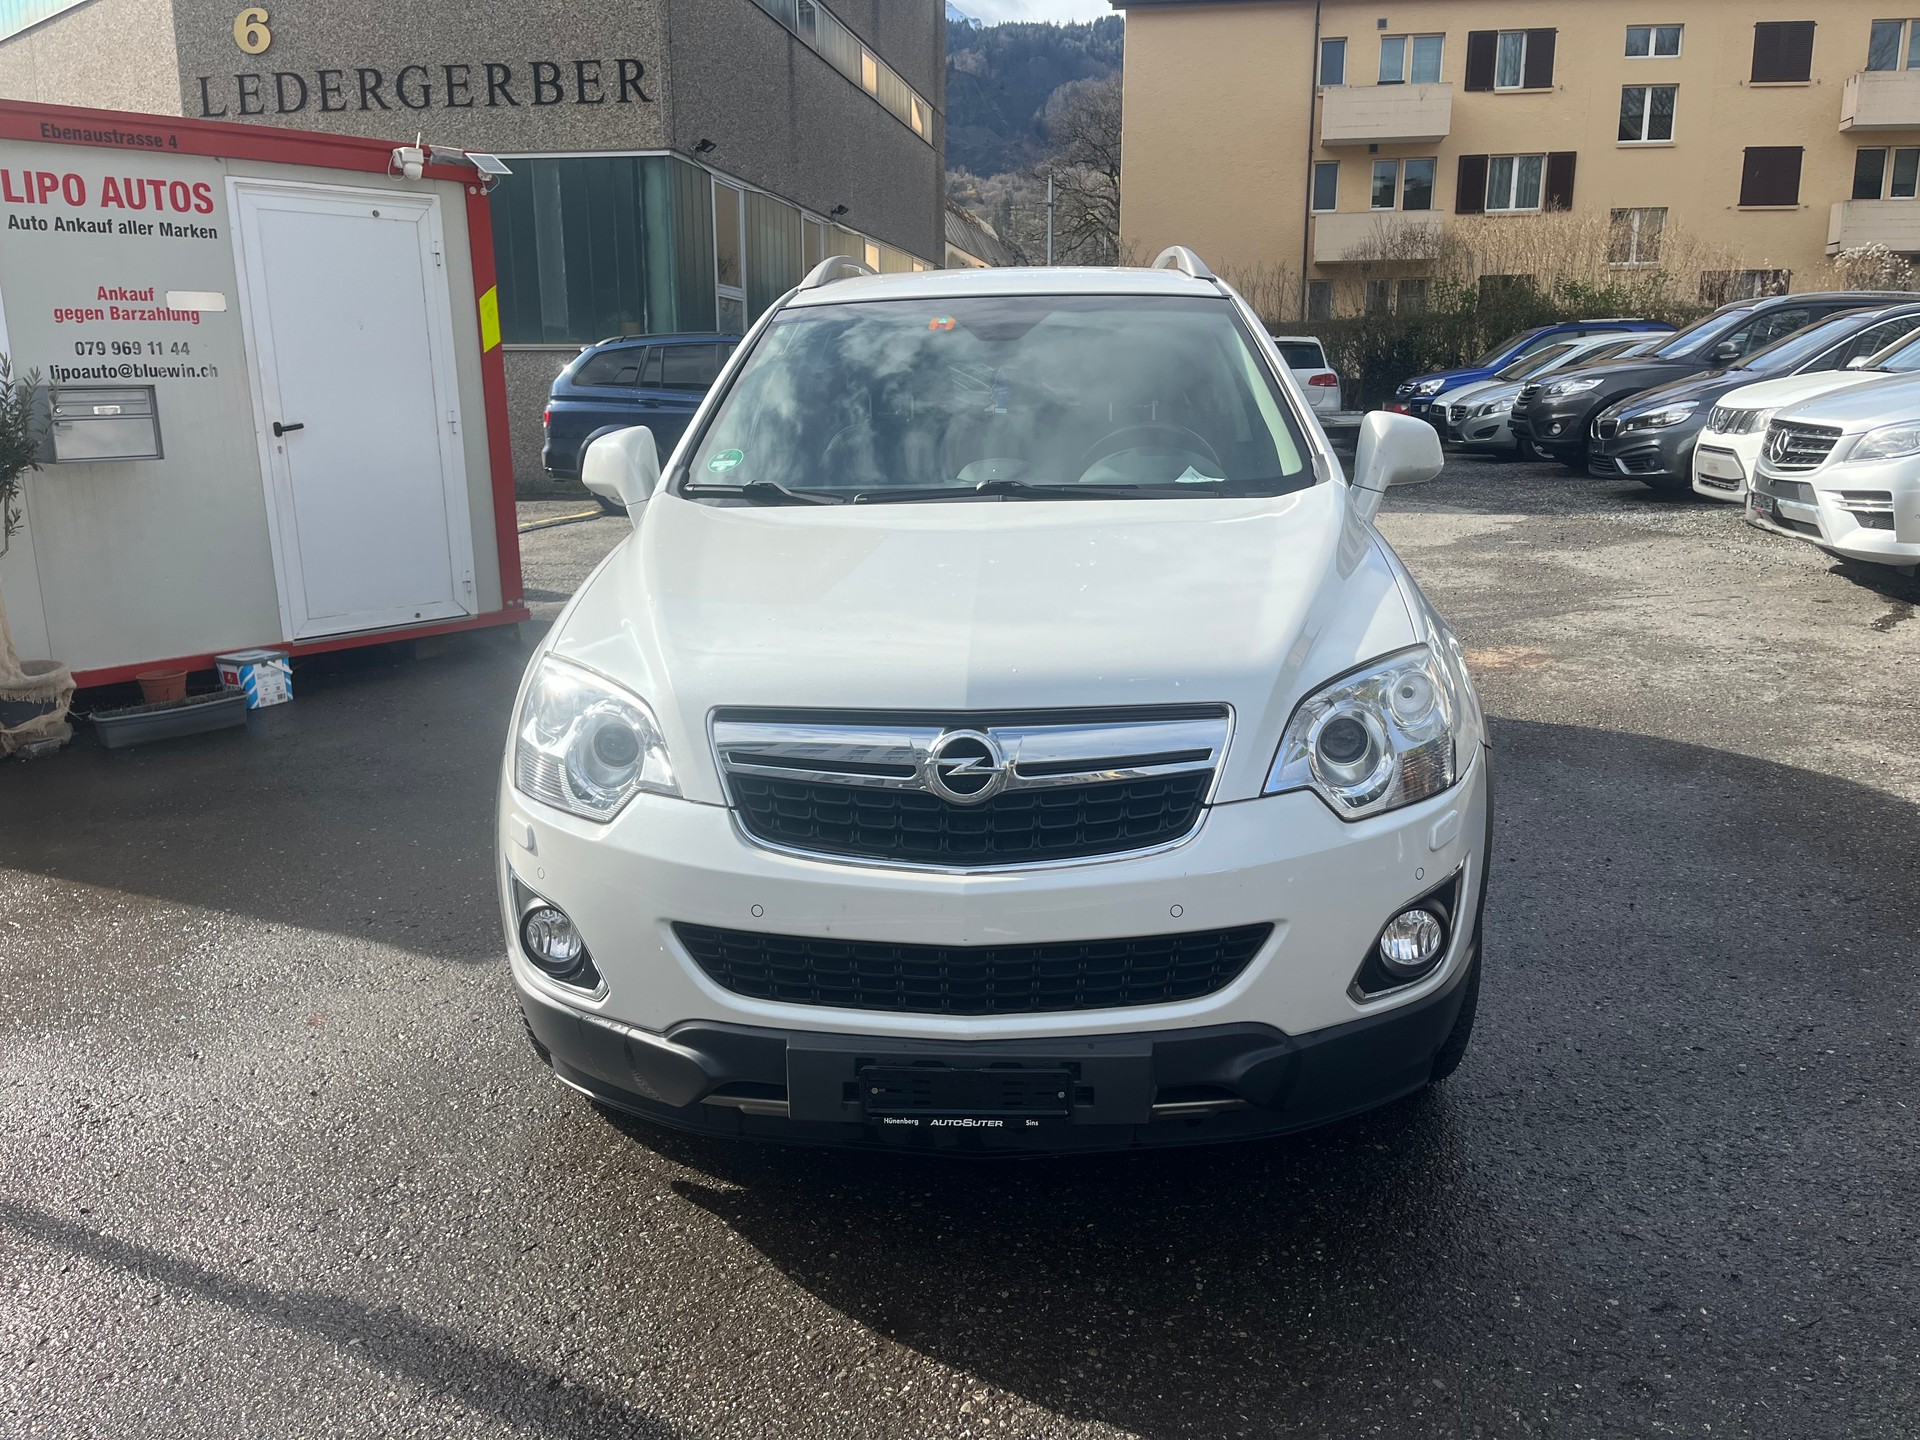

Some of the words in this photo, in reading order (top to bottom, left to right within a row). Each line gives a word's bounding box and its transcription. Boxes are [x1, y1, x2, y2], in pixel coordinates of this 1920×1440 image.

[233, 7, 272, 55] 6
[197, 58, 654, 118] LEDERGERBER
[40, 122, 163, 148] Ebenaustrasse
[168, 135, 178, 149] 4
[0, 168, 87, 207] LIPO
[100, 176, 215, 214] AUTOS
[8, 214, 48, 231] Auto
[54, 216, 113, 234] Ankauf
[118, 219, 154, 236] aller
[159, 221, 218, 240] Marken
[97, 286, 154, 302] Ankauf
[53, 307, 104, 324] gegen
[109, 305, 200, 325] Barzahlung
[74, 341, 106, 356] 079
[111, 341, 142, 356] 969
[147, 341, 163, 356] 11
[170, 341, 190, 356] 44
[49, 363, 218, 383] lipoauto@bluewin.ch
[883, 1117, 919, 1126] Hünenberg
